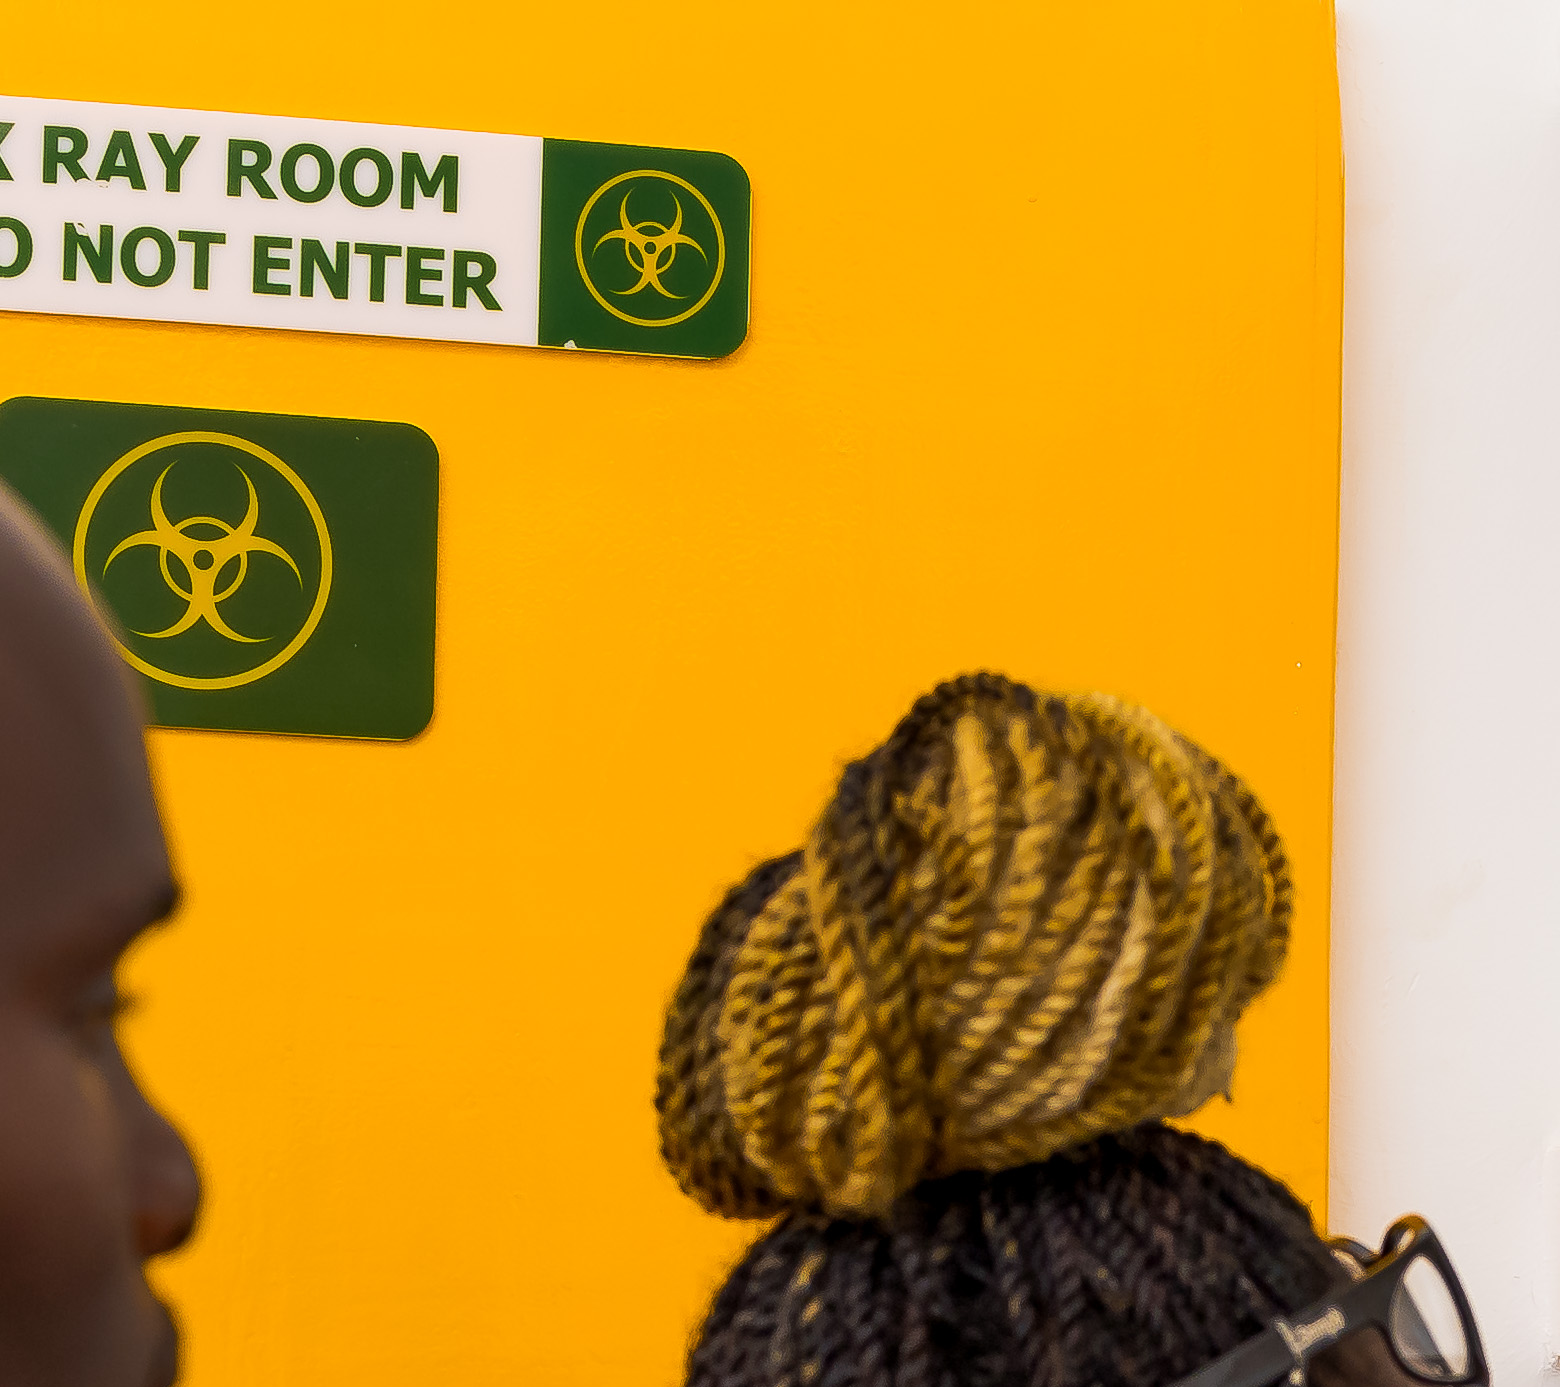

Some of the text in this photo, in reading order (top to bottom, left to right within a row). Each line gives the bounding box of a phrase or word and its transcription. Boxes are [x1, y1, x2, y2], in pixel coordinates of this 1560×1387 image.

[42, 125, 201, 193] RAY
[226, 138, 459, 214] ROOM
[62, 221, 226, 291] NOT
[252, 234, 504, 312] ENTER
